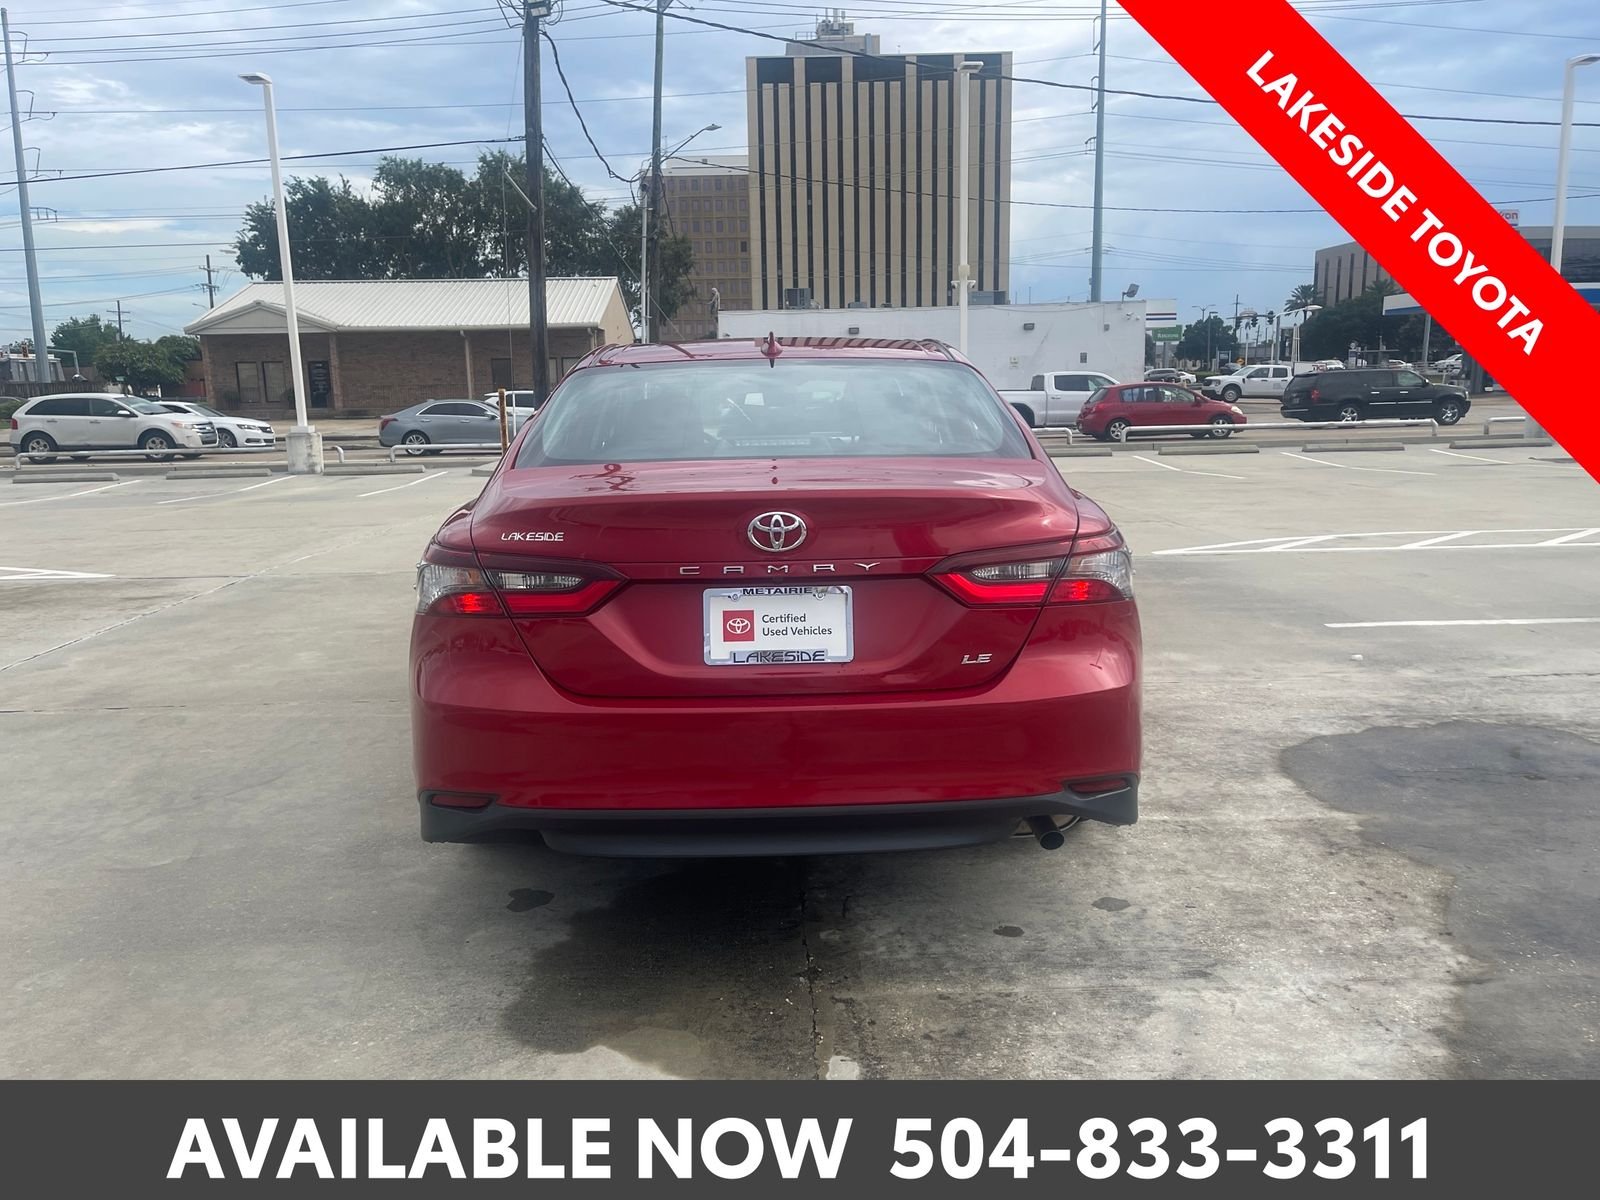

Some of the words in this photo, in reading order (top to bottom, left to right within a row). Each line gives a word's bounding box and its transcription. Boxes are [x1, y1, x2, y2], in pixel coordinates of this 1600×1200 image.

[501, 531, 565, 542] LAKESIDE
[679, 562, 881, 575] CAMRY
[742, 587, 813, 595] METAIRIE
[762, 613, 807, 624] Certified
[762, 627, 788, 637] Used
[790, 626, 833, 636] Vehicles
[961, 653, 993, 665] LE
